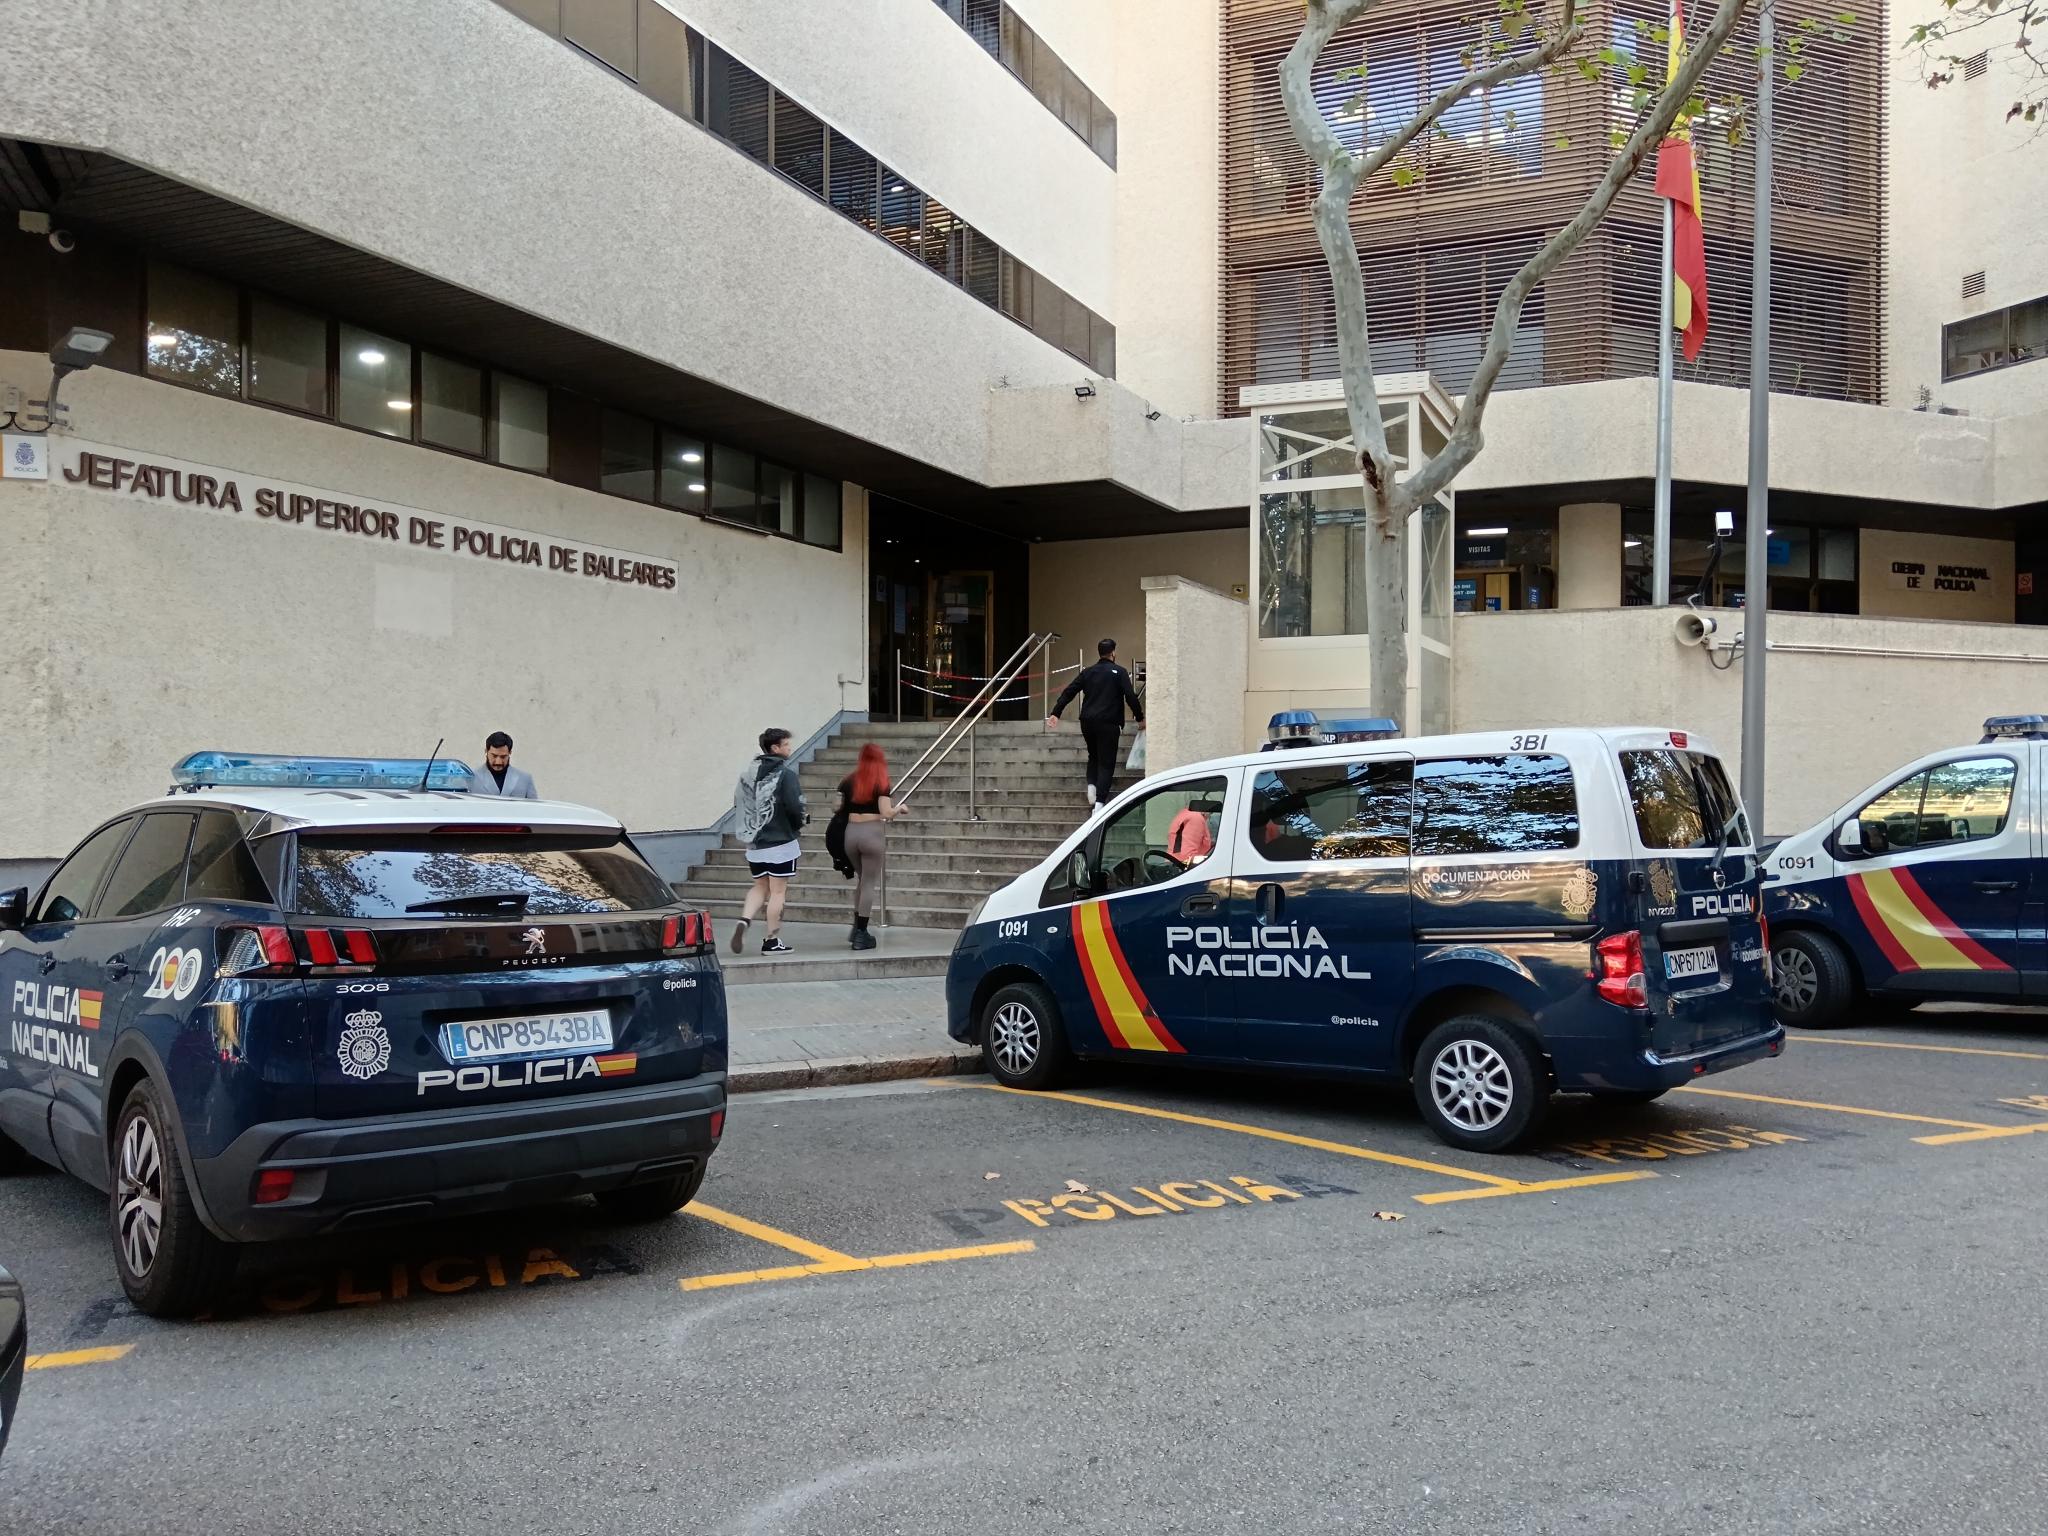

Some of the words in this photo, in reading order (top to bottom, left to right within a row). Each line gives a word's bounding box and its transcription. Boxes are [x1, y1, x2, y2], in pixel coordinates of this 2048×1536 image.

[63, 451, 243, 512] JEFATURA
[255, 487, 400, 540] SUPERIOR
[409, 516, 445, 548] DE
[453, 526, 542, 567] POLICIA
[549, 545, 577, 573] DE
[583, 551, 676, 590] BALEARES
[1468, 545, 1492, 554] VISITAS
[1937, 565, 1991, 580] NACIONAL
[1907, 576, 1921, 589] DE
[1934, 577, 1977, 592] POLICIA
[1510, 734, 1549, 751] 3BI
[1422, 867, 1531, 884] DOCUMENTACIÓN
[1648, 906, 1676, 917] NV200
[1692, 889, 1751, 916] POLICÍA
[1166, 920, 1329, 949] POLICÍA
[502, 956, 567, 966] PEUGEOT
[1168, 953, 1372, 980] NACIONAL
[336, 983, 390, 994] 3008
[465, 1015, 606, 1052] CNP8543BA
[12, 1020, 99, 1078] NACIONAL
[1000, 1175, 1304, 1228] POLICIA
[262, 1247, 581, 1313] OLICIA
